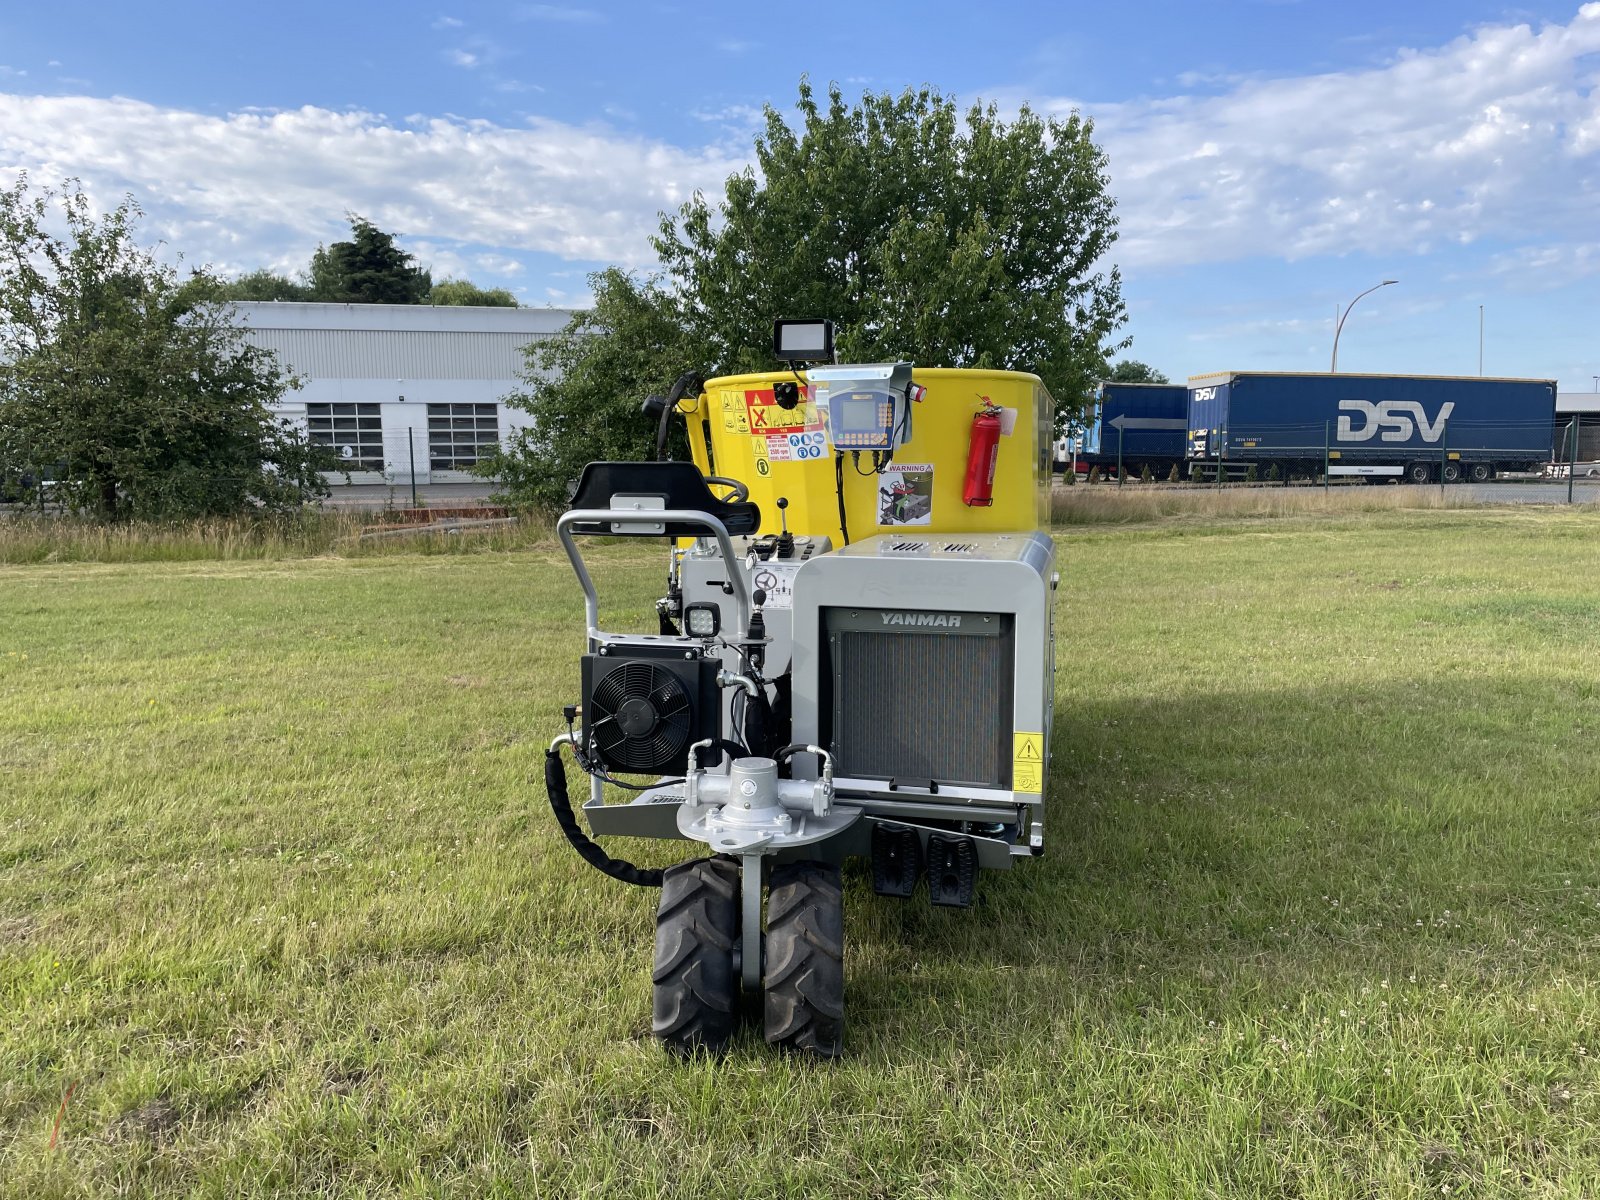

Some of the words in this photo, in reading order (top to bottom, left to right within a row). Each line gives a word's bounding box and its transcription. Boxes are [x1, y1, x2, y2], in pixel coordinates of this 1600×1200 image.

[1195, 387, 1216, 401] DSV
[1337, 399, 1455, 442] DSV
[881, 613, 961, 627] YANMAR
